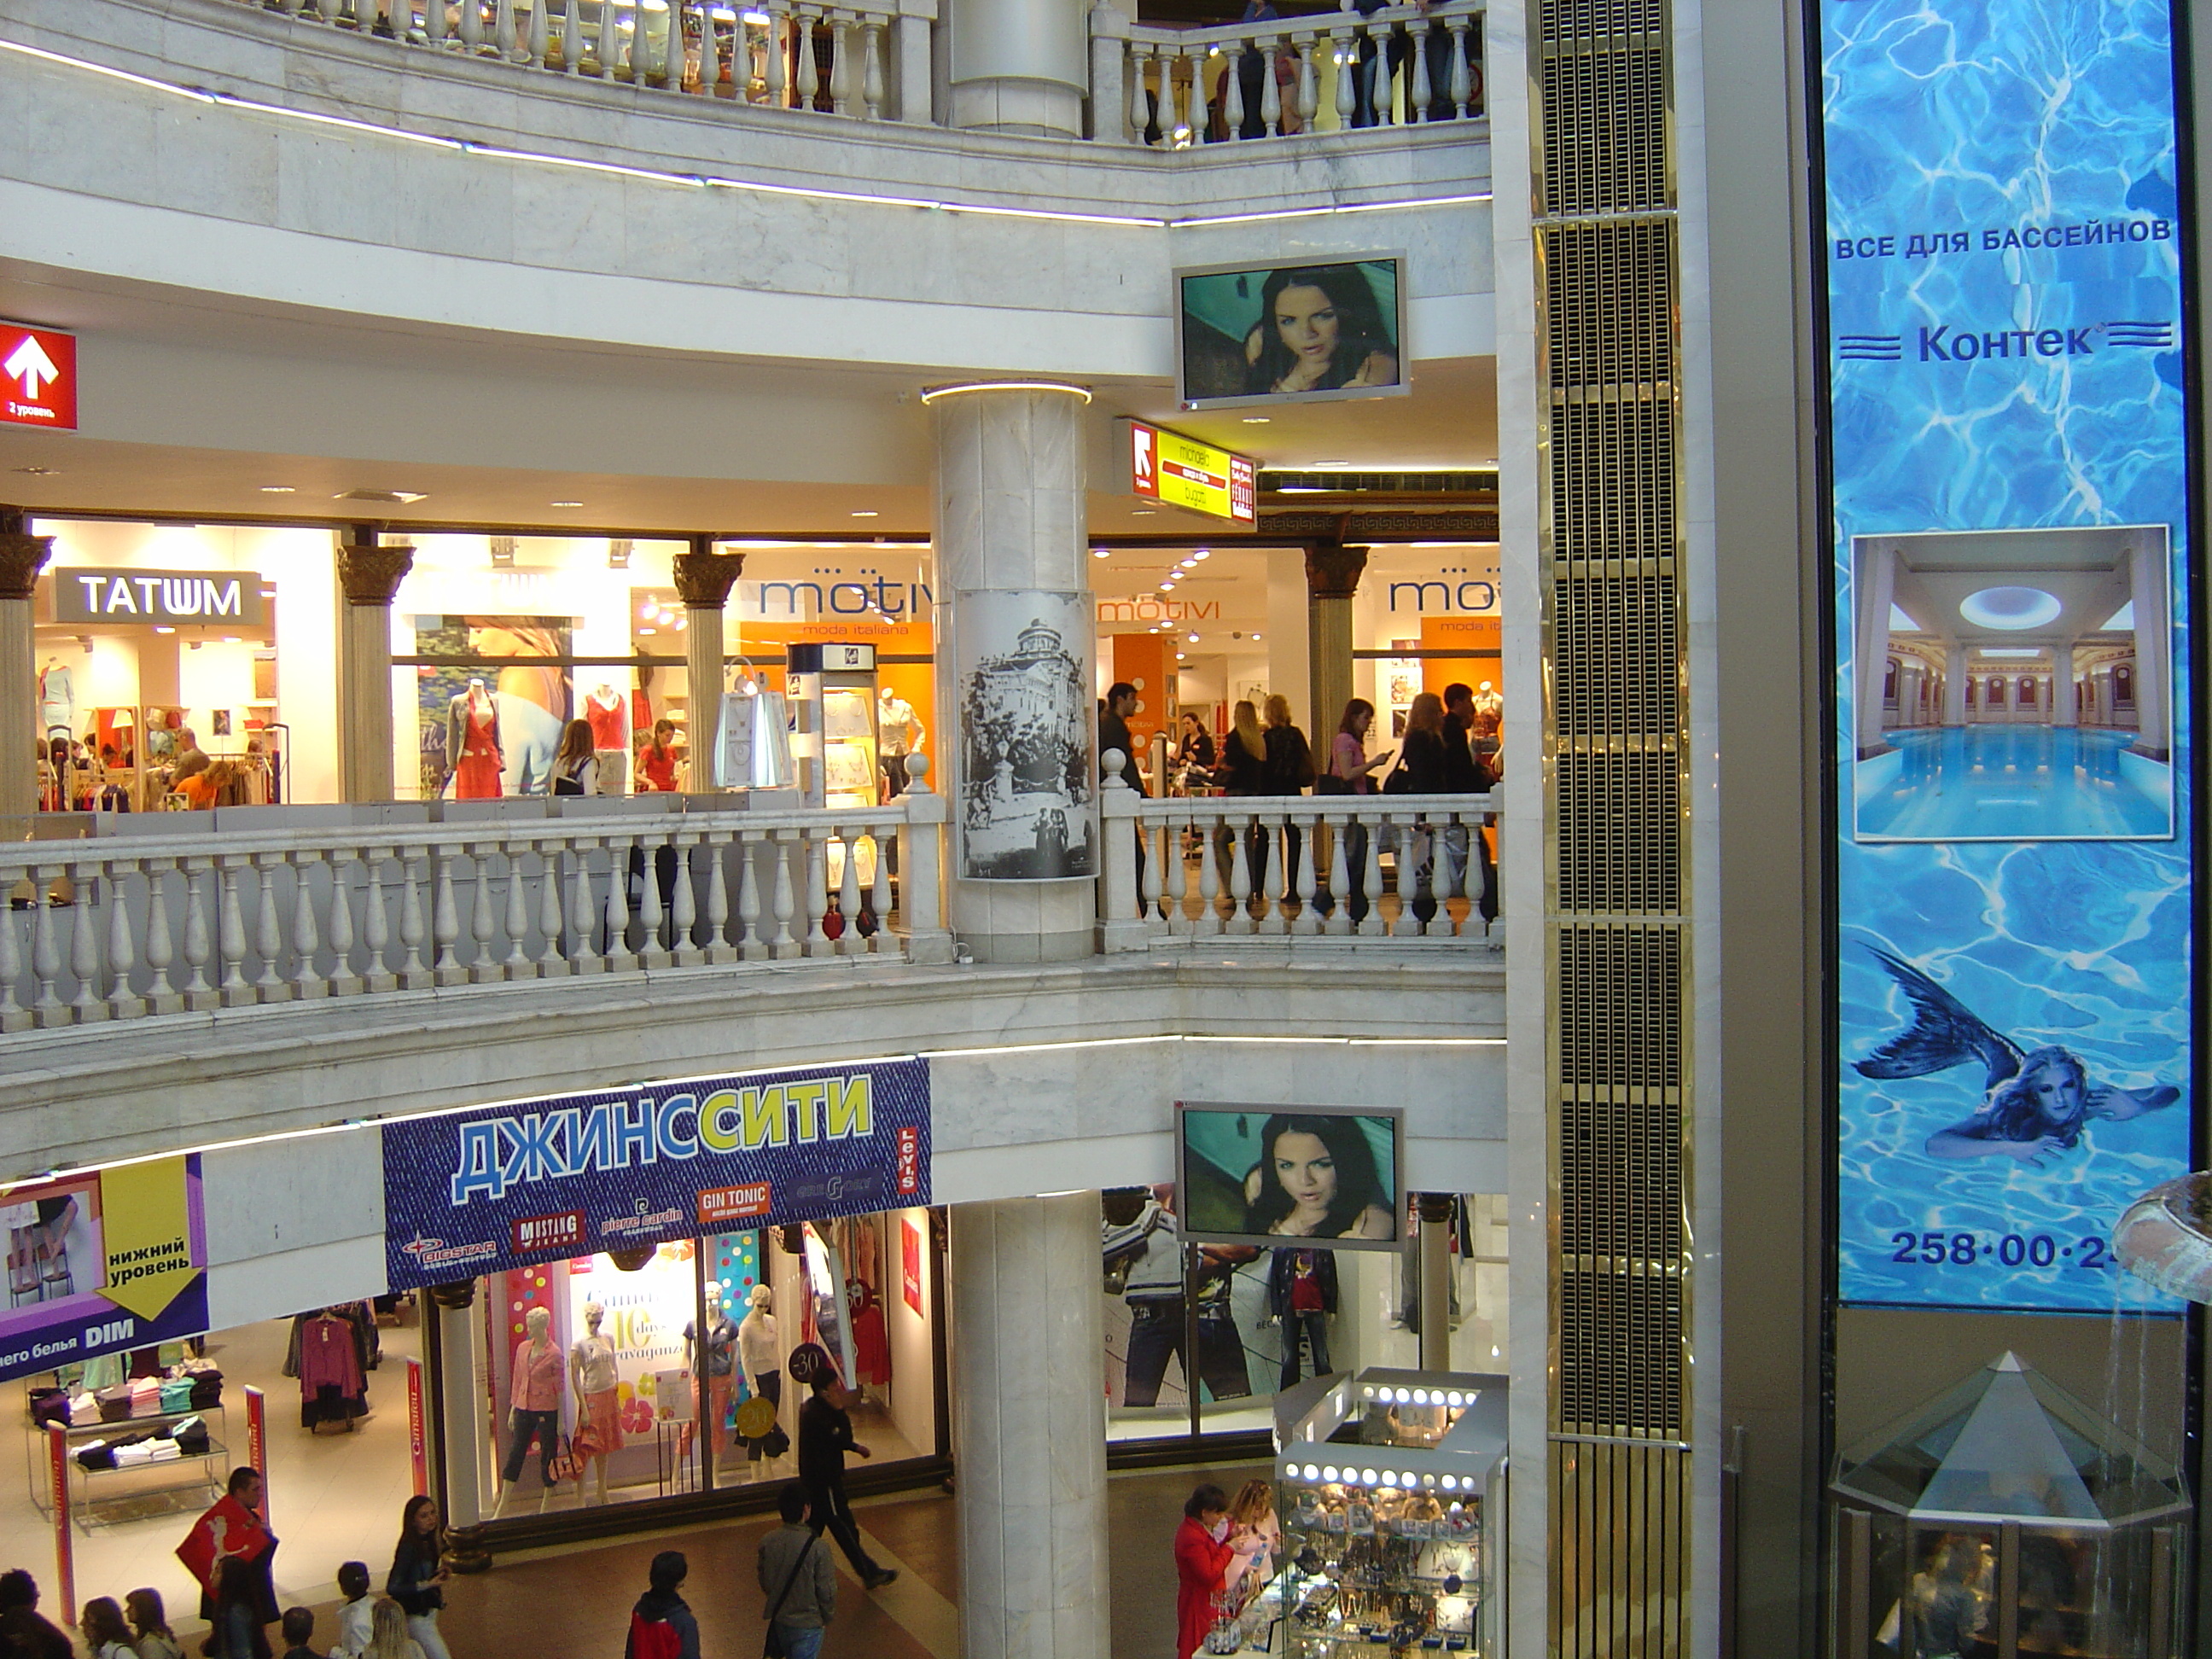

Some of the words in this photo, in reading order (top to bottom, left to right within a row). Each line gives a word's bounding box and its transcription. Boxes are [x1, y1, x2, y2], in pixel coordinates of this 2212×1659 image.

[1836, 236, 1895, 259] ВСЕ
[1905, 232, 1970, 259] ДЛЯ
[1982, 218, 2171, 250] БАССЕЙНОВ
[1918, 323, 2093, 363] Контек
[9, 401, 16, 413] 2
[17, 405, 55, 418] уровень
[803, 624, 847, 635] moda
[854, 624, 909, 635] italiana
[1441, 621, 1484, 632] moda
[703, 1194, 725, 1209] GIN
[727, 1186, 765, 1206] TONIC
[521, 1214, 578, 1241] MUSTANG
[602, 1217, 640, 1236] pierre
[643, 1208, 683, 1225] cardin
[109, 1237, 184, 1266] нижний
[536, 1233, 578, 1247] JEANS
[110, 1257, 189, 1288] уровень
[85, 1318, 135, 1348] DIM
[32, 1337, 78, 1359] белья
